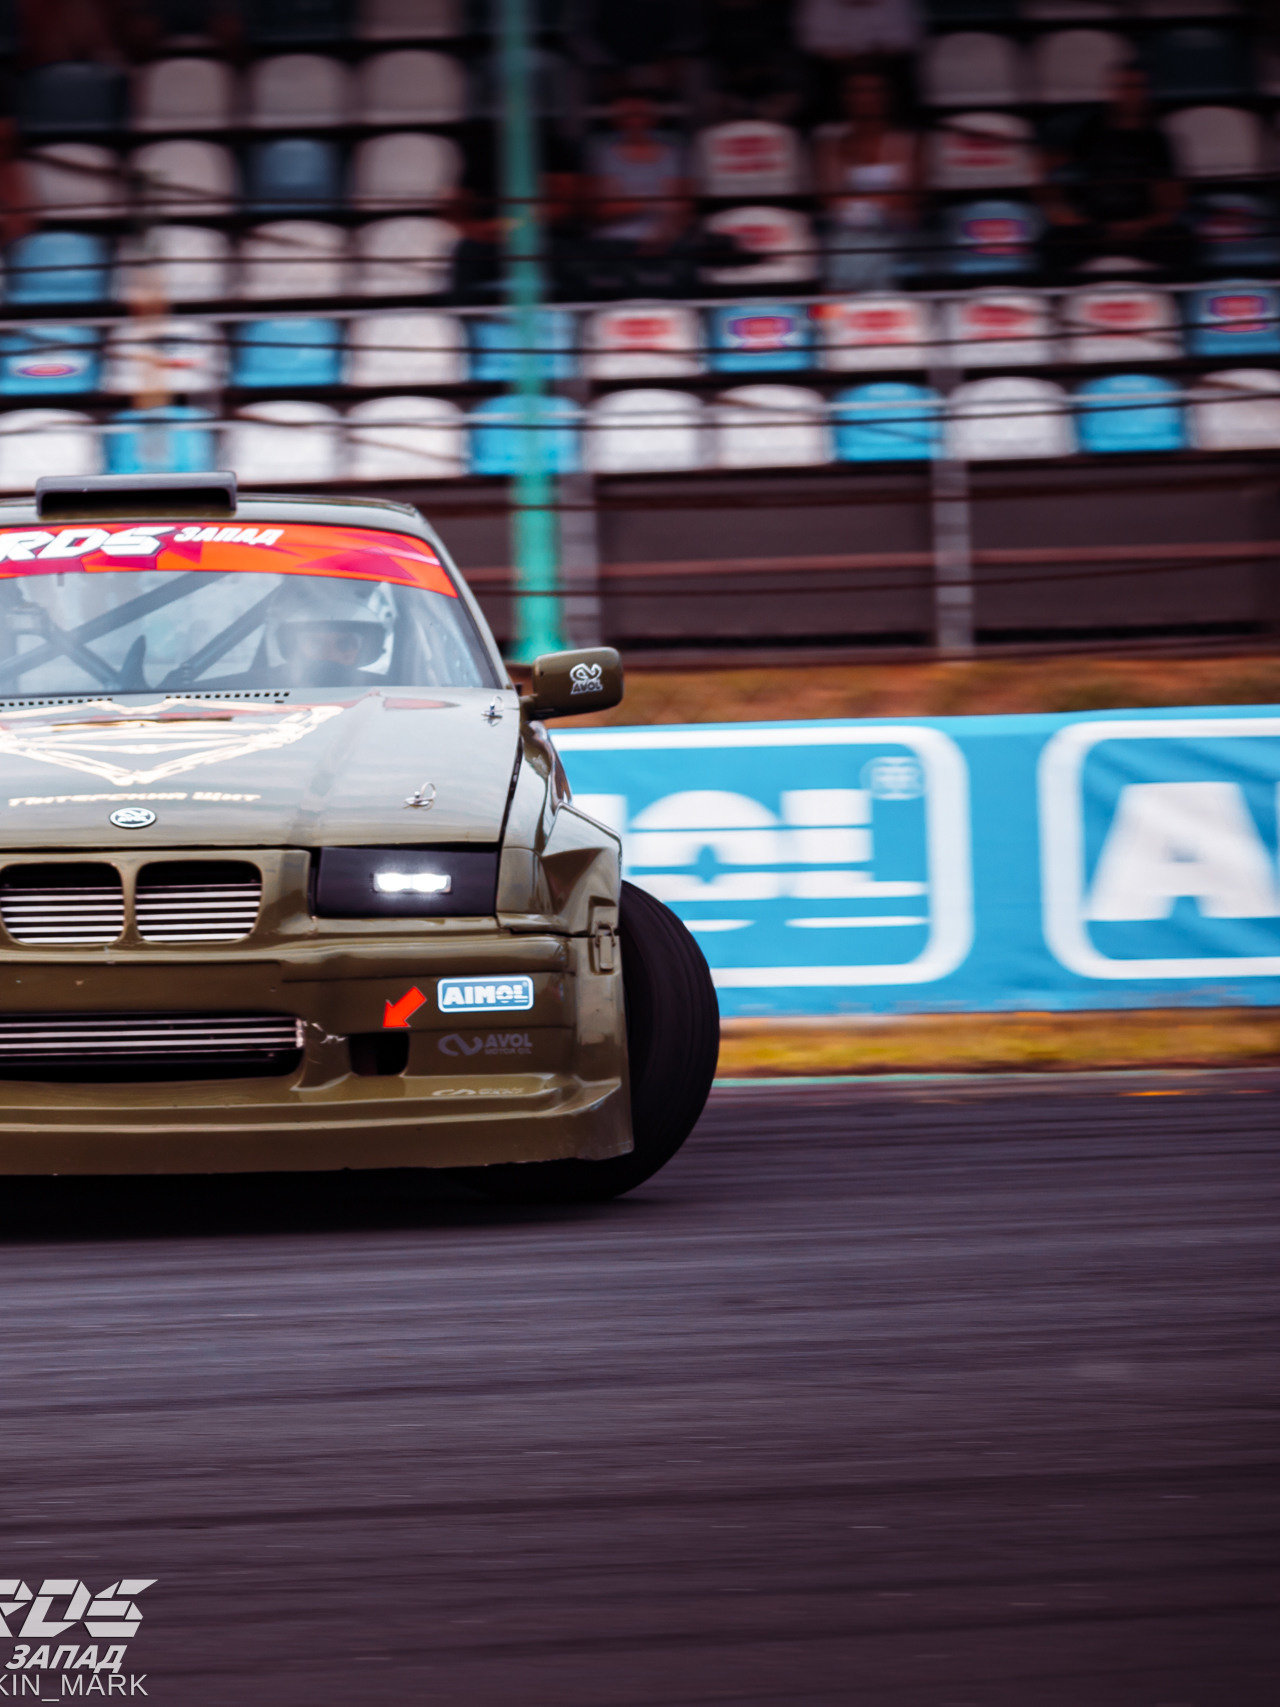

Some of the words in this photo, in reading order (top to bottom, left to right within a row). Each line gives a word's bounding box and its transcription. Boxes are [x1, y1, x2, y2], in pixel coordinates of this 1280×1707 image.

[174, 527, 285, 545] ЗАПАД
[571, 680, 603, 695] AVOL
[443, 985, 528, 1005] AIMOL
[484, 1033, 532, 1048] AVOL
